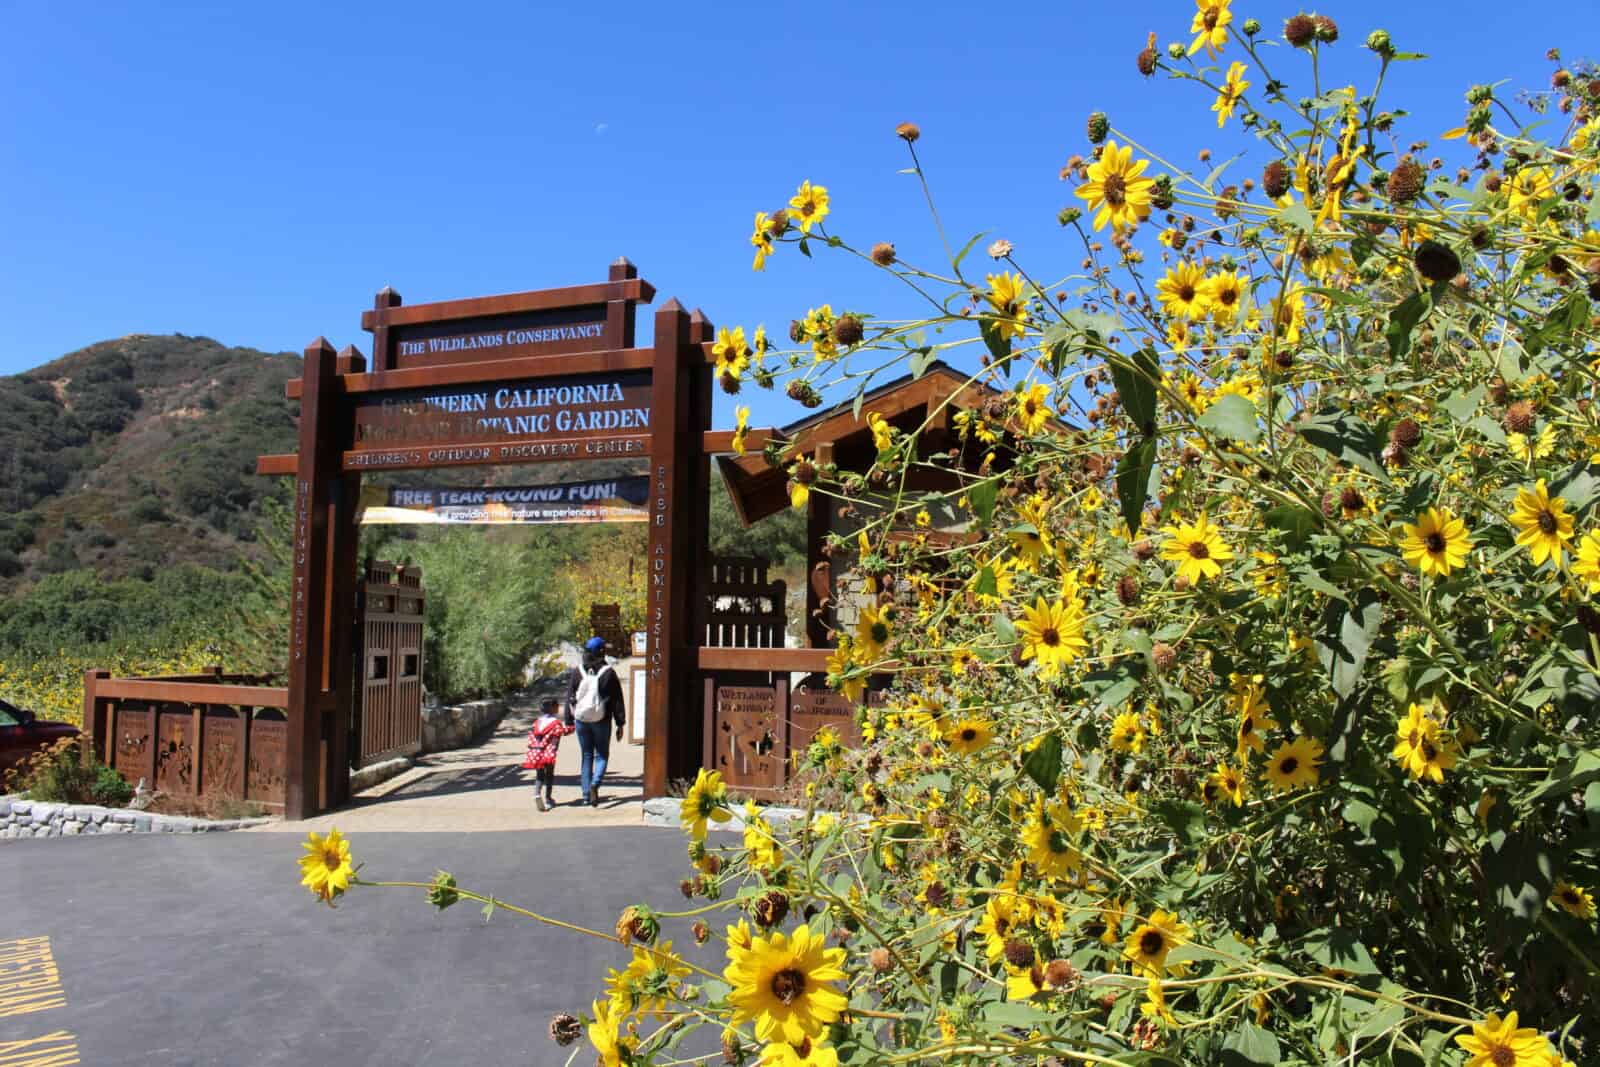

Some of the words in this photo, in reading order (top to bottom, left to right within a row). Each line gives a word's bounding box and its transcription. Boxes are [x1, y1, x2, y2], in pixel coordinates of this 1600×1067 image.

[400, 341, 425, 356] THE
[428, 334, 503, 353] WILDLANDS
[506, 324, 603, 345] CONSERVANCY
[381, 391, 488, 416] THERN
[494, 383, 625, 409] CALIFORNIA
[460, 413, 550, 436] OTANIC
[555, 408, 650, 431] GARDEN
[428, 447, 491, 461] OUTDOOR
[501, 442, 579, 457] DISCOVERY
[585, 440, 643, 453] CENTER
[394, 489, 432, 505] FREE
[568, 482, 617, 500] FUN!
[511, 506, 540, 518] nature
